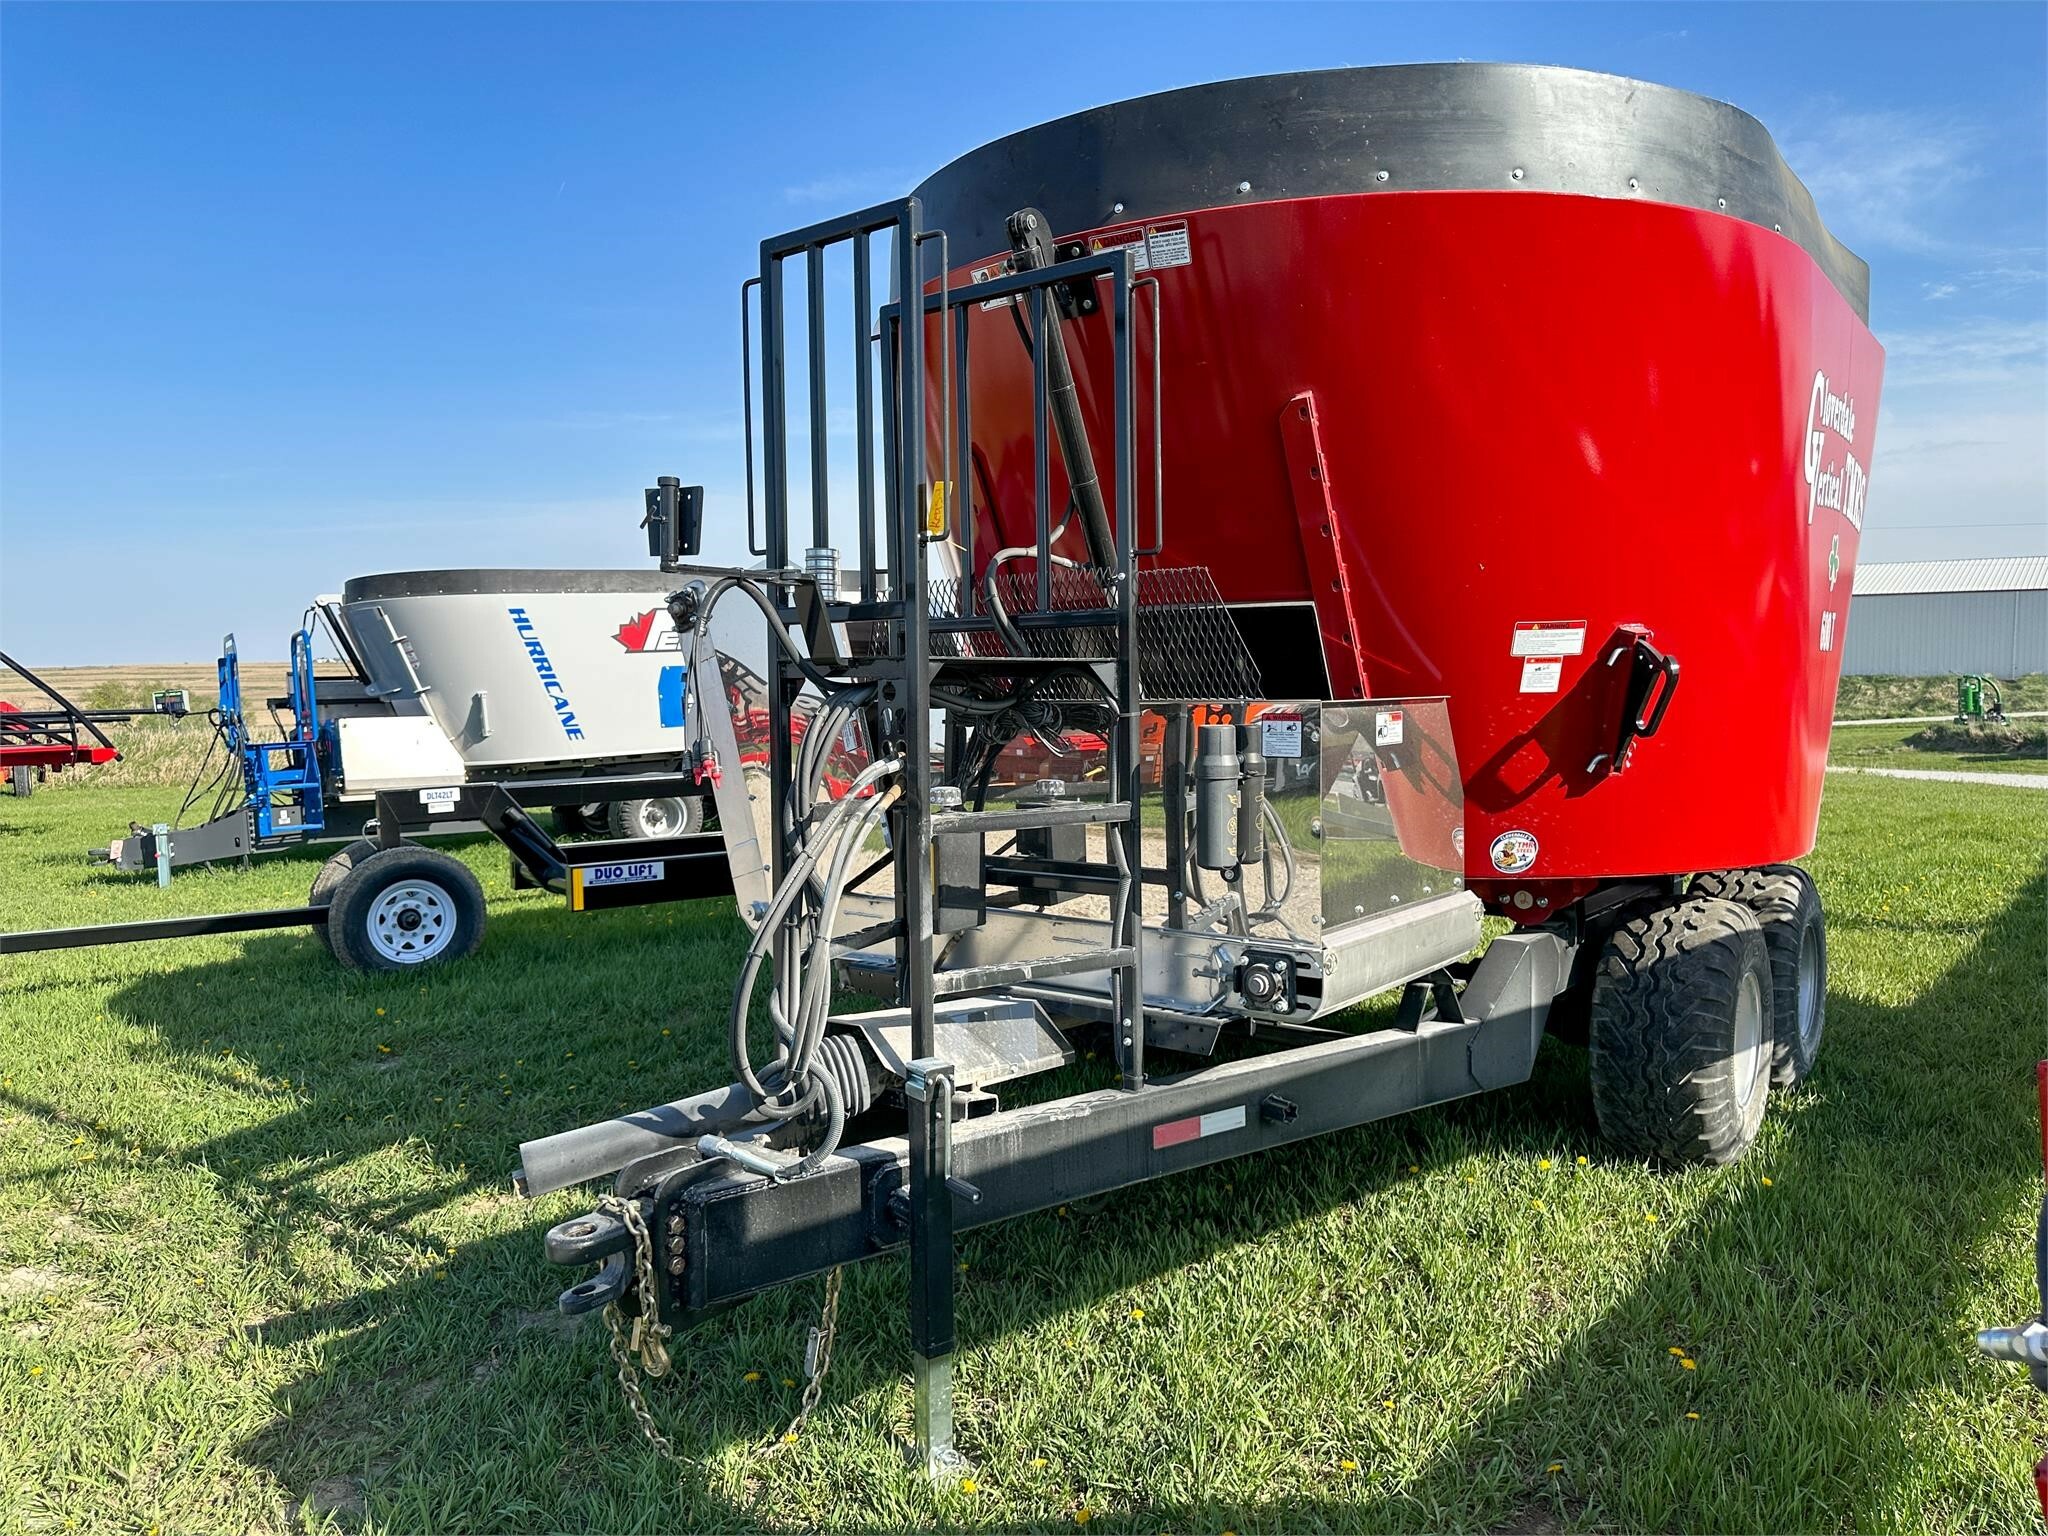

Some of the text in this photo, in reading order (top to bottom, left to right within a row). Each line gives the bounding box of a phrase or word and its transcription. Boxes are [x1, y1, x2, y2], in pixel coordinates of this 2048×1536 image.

[1103, 230, 1142, 247] DANGER
[1804, 369, 1855, 485] Cloverdale
[1808, 430, 1845, 525] Vertical
[508, 608, 585, 741] HURRICANE
[426, 791, 454, 800] DLT42LT
[594, 866, 624, 880] DUO
